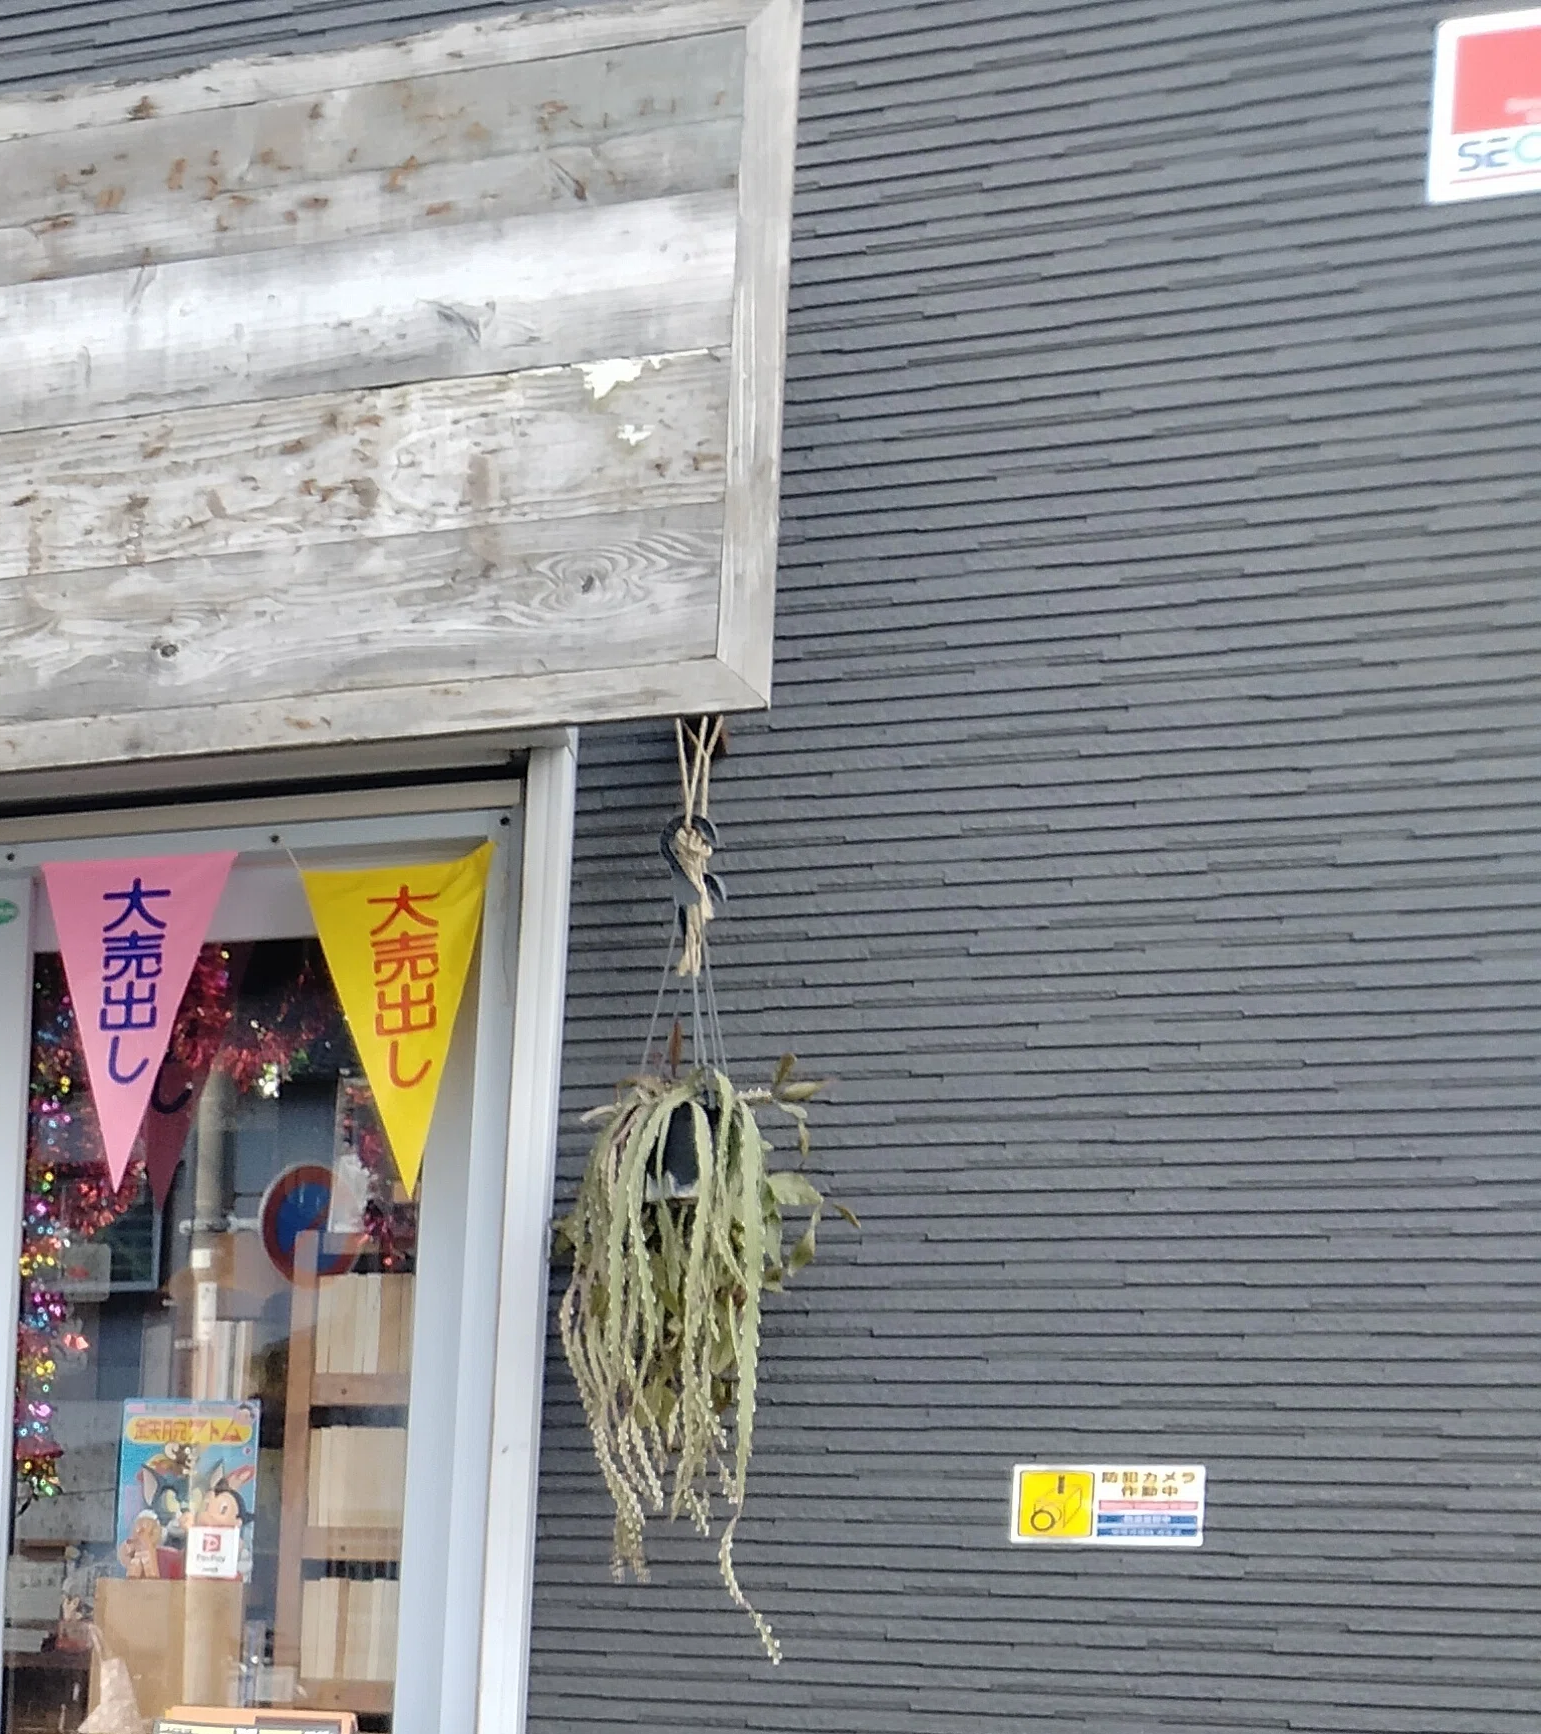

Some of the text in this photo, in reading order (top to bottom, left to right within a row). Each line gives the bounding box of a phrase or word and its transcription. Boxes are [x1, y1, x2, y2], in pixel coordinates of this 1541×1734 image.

[99, 878, 172, 1084] 大売出し
[367, 884, 440, 1090] 大売出し
[1101, 1471, 1196, 1484] 防犯カメラ
[1121, 1485, 1179, 1497] 作動中
